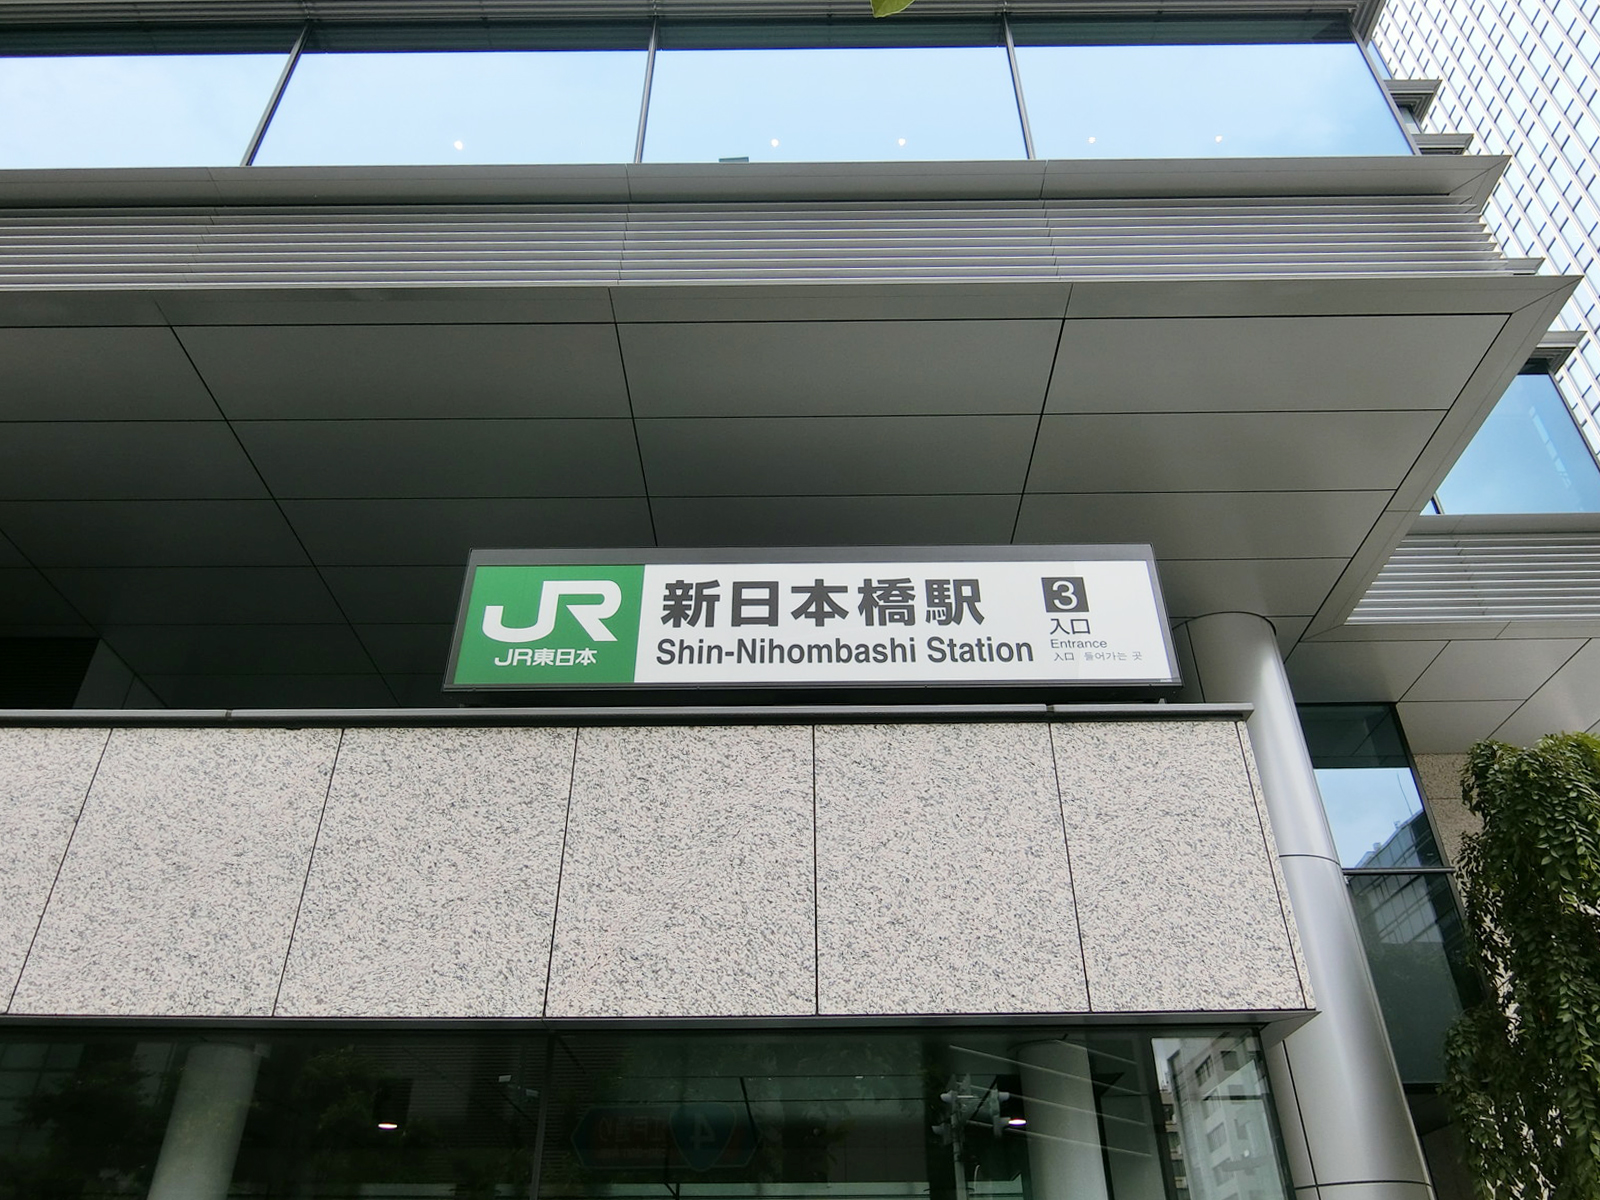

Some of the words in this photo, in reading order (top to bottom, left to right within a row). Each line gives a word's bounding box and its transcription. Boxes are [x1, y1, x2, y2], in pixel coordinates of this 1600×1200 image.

[661, 578, 985, 629] 新日本橋駅
[1052, 580, 1079, 611] 3
[482, 580, 622, 643] JR
[1049, 618, 1092, 636] 入口
[656, 636, 918, 666] Shin-Nihombashi
[926, 636, 1035, 663] Station
[1049, 638, 1108, 649] Entrance
[493, 647, 598, 668] JR東日本
[1053, 651, 1076, 662] 入口
